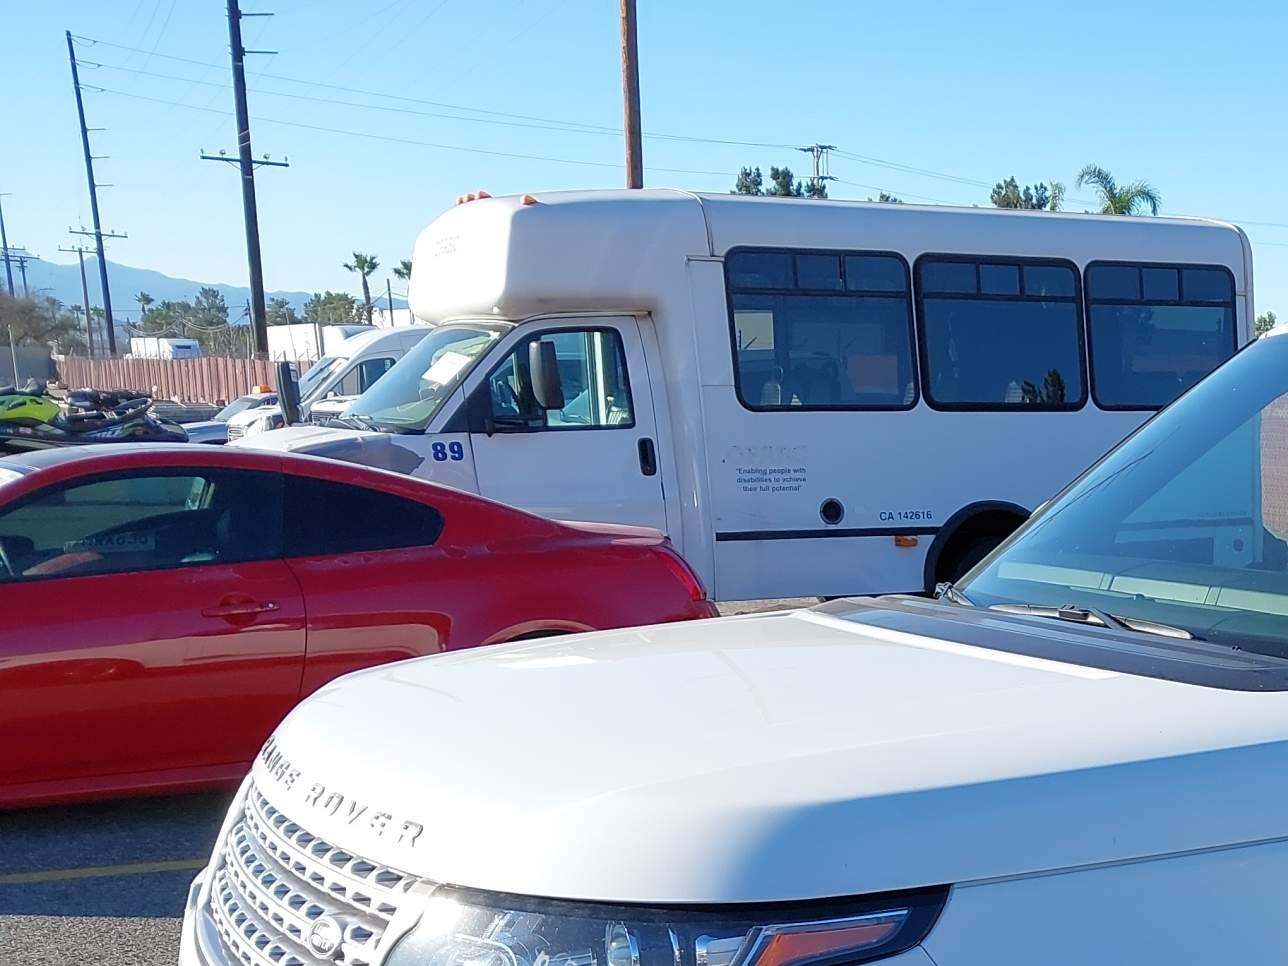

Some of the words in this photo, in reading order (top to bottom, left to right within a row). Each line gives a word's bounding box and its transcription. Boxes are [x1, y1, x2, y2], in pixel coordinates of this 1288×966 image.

[431, 441, 464, 462] 89
[769, 467, 791, 476] people
[736, 476, 773, 484] disabilities
[880, 511, 895, 521] CA
[897, 510, 933, 520] 142616
[261, 735, 302, 791] RANGE
[304, 782, 424, 849] ROVER
